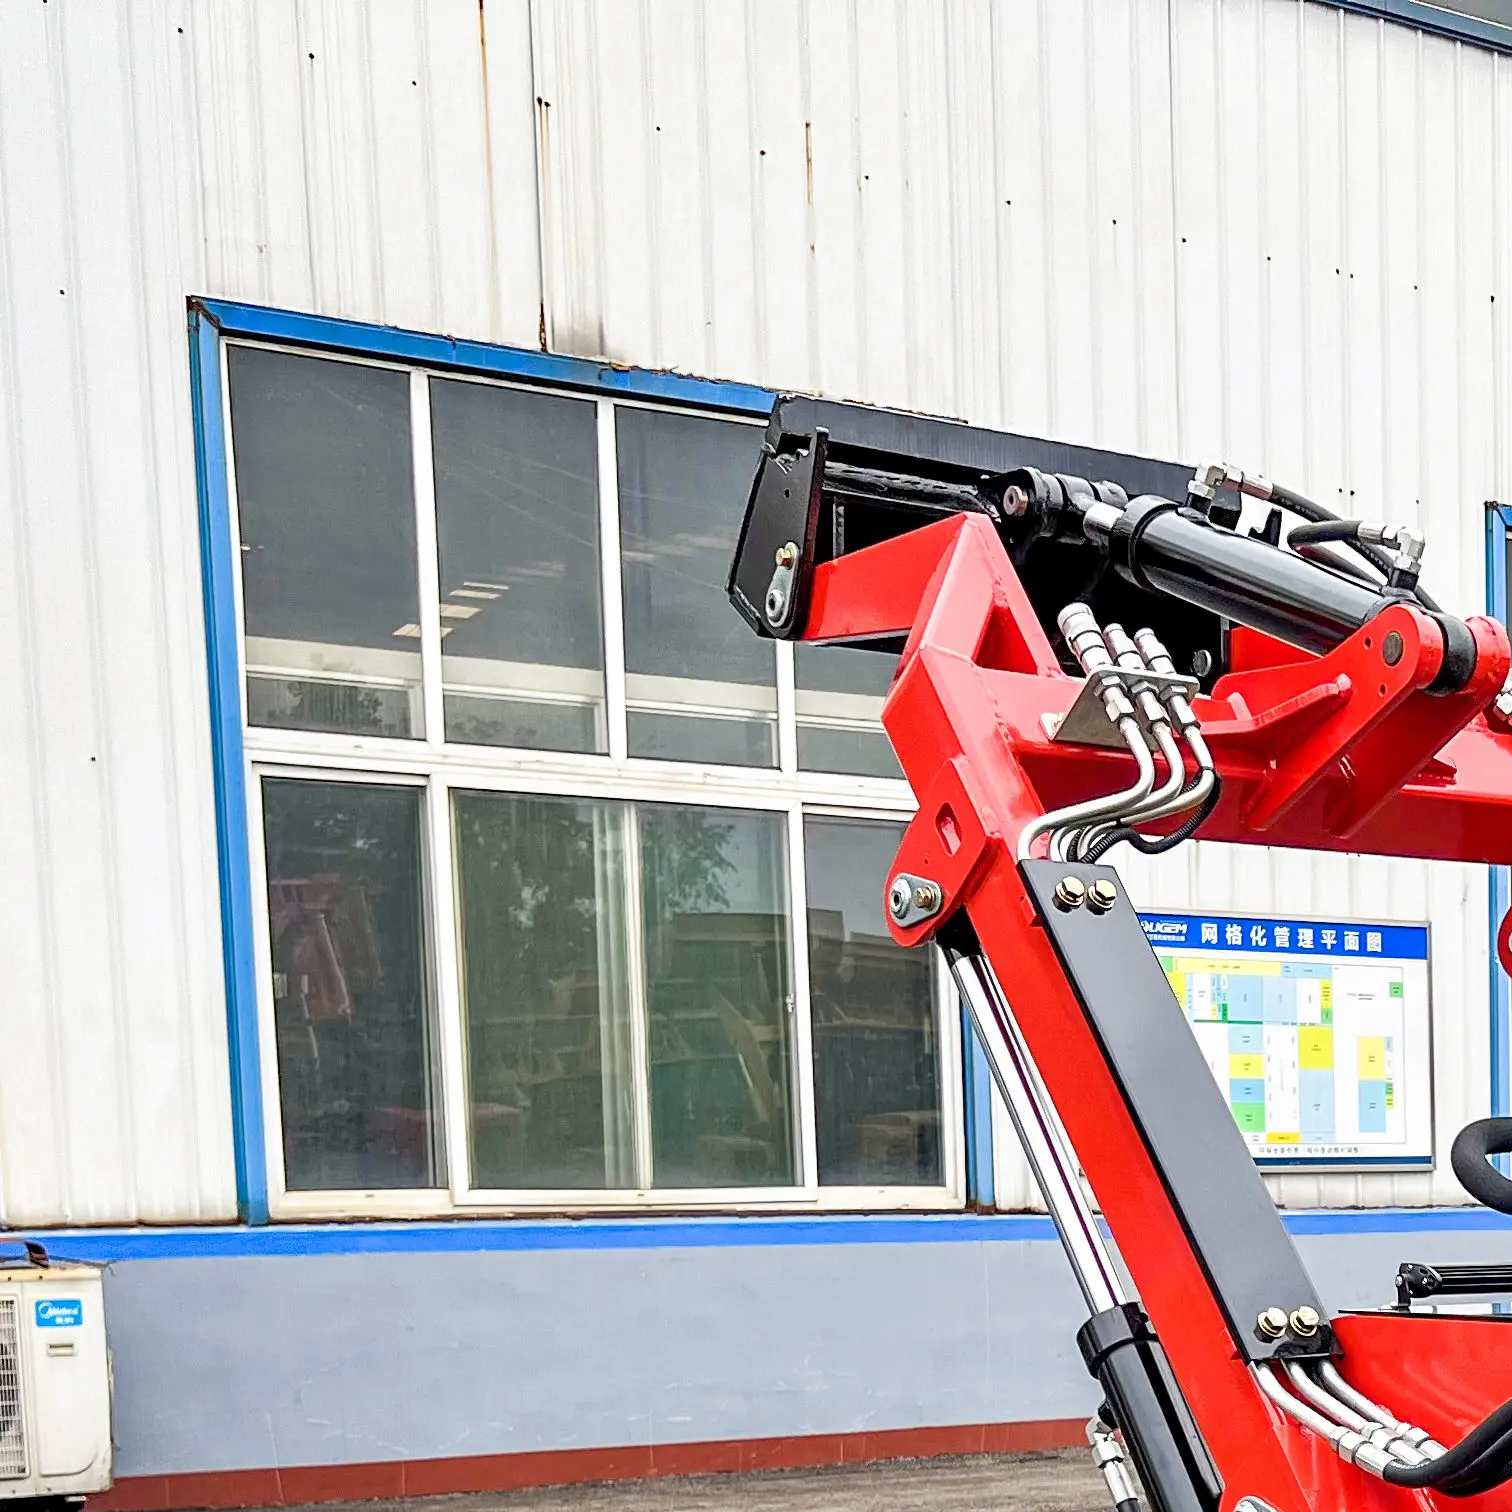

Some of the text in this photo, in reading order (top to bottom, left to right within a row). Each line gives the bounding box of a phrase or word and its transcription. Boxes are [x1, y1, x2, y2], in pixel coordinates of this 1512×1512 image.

[1201, 922, 1382, 953] 网格化管理平面图
